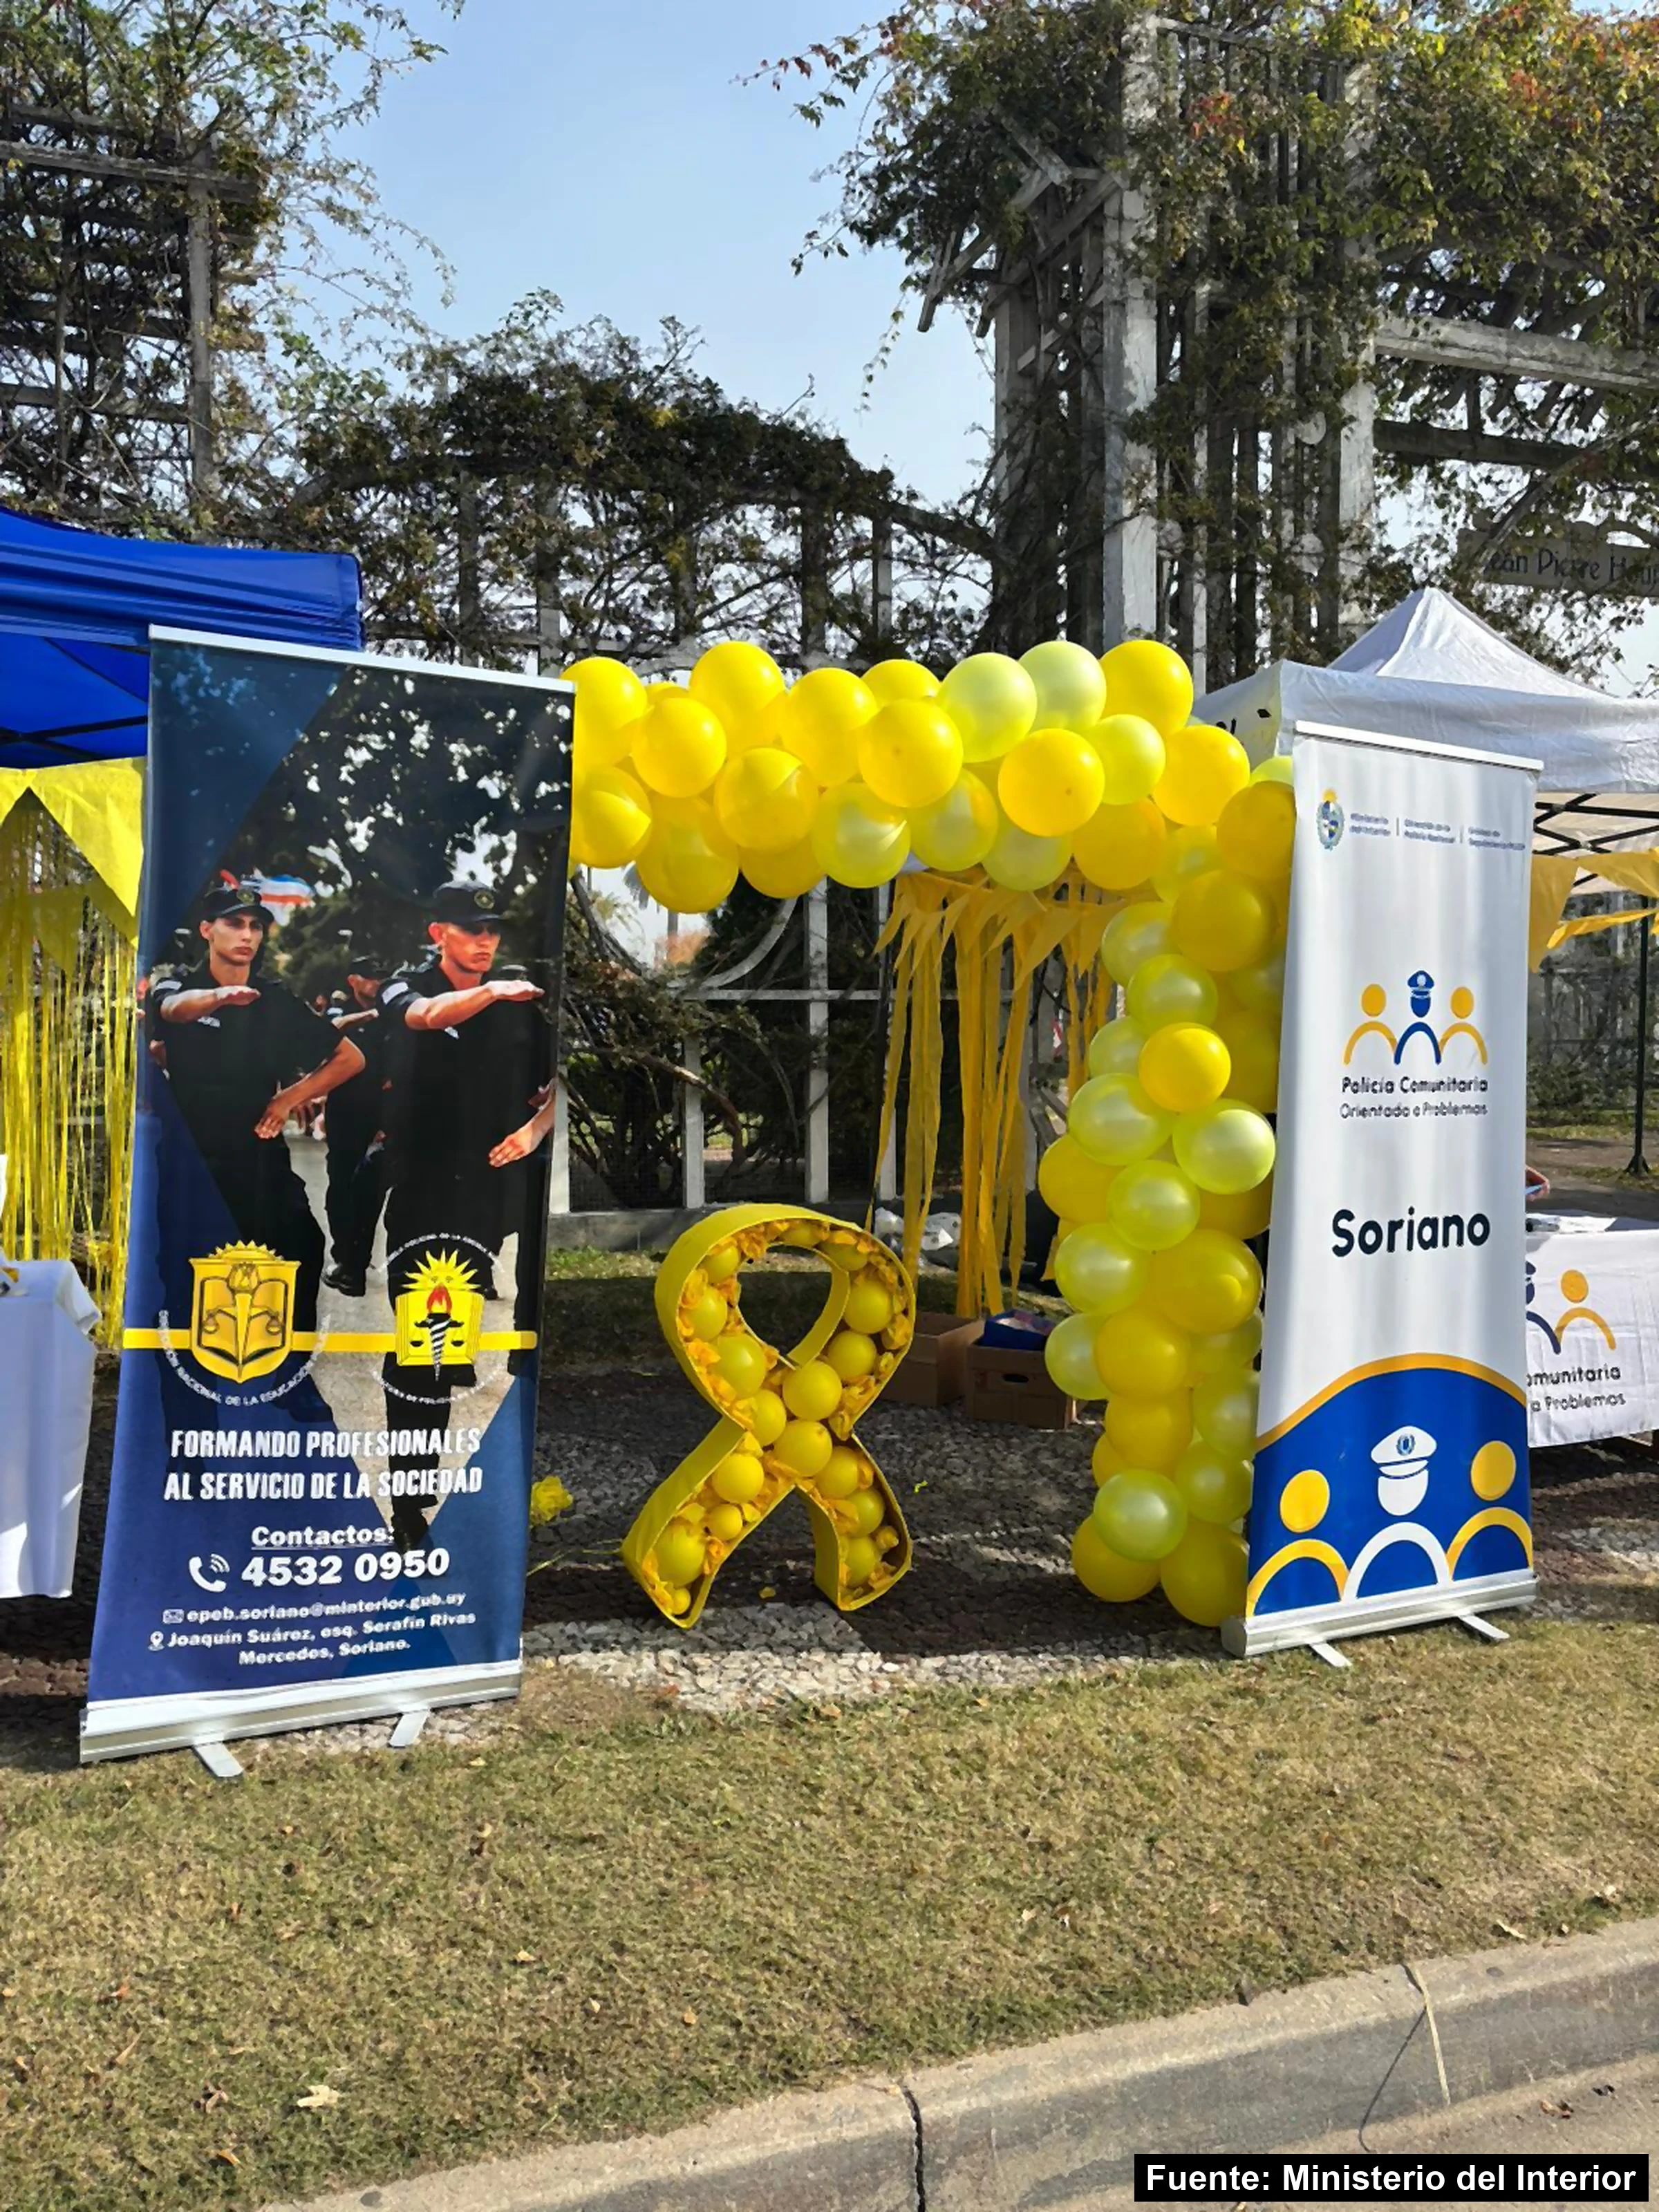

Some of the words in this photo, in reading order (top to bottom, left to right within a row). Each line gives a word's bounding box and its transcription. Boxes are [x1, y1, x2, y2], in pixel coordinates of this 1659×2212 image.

[1399, 1076, 1488, 1094] Comunitaria
[1423, 1101, 1488, 1116] Problemas
[1331, 1206, 1491, 1257] Soriano
[1545, 1393, 1626, 1411] Problemas
[171, 1430, 301, 1459] FORMANDO
[306, 1427, 482, 1458] PROFESIONALES
[163, 1472, 194, 1501] AL
[200, 1472, 306, 1500] SERVICIO
[310, 1472, 338, 1499] DE
[343, 1472, 371, 1499] LA
[377, 1467, 482, 1497] SOCIEDAD
[251, 1525, 395, 1547] Contactos:
[241, 1555, 343, 1586] 4532
[354, 1548, 450, 1582] 0950
[320, 1625, 359, 1639] esq.
[429, 1612, 477, 1627] Rivas
[338, 1639, 411, 1656] Soriano.
